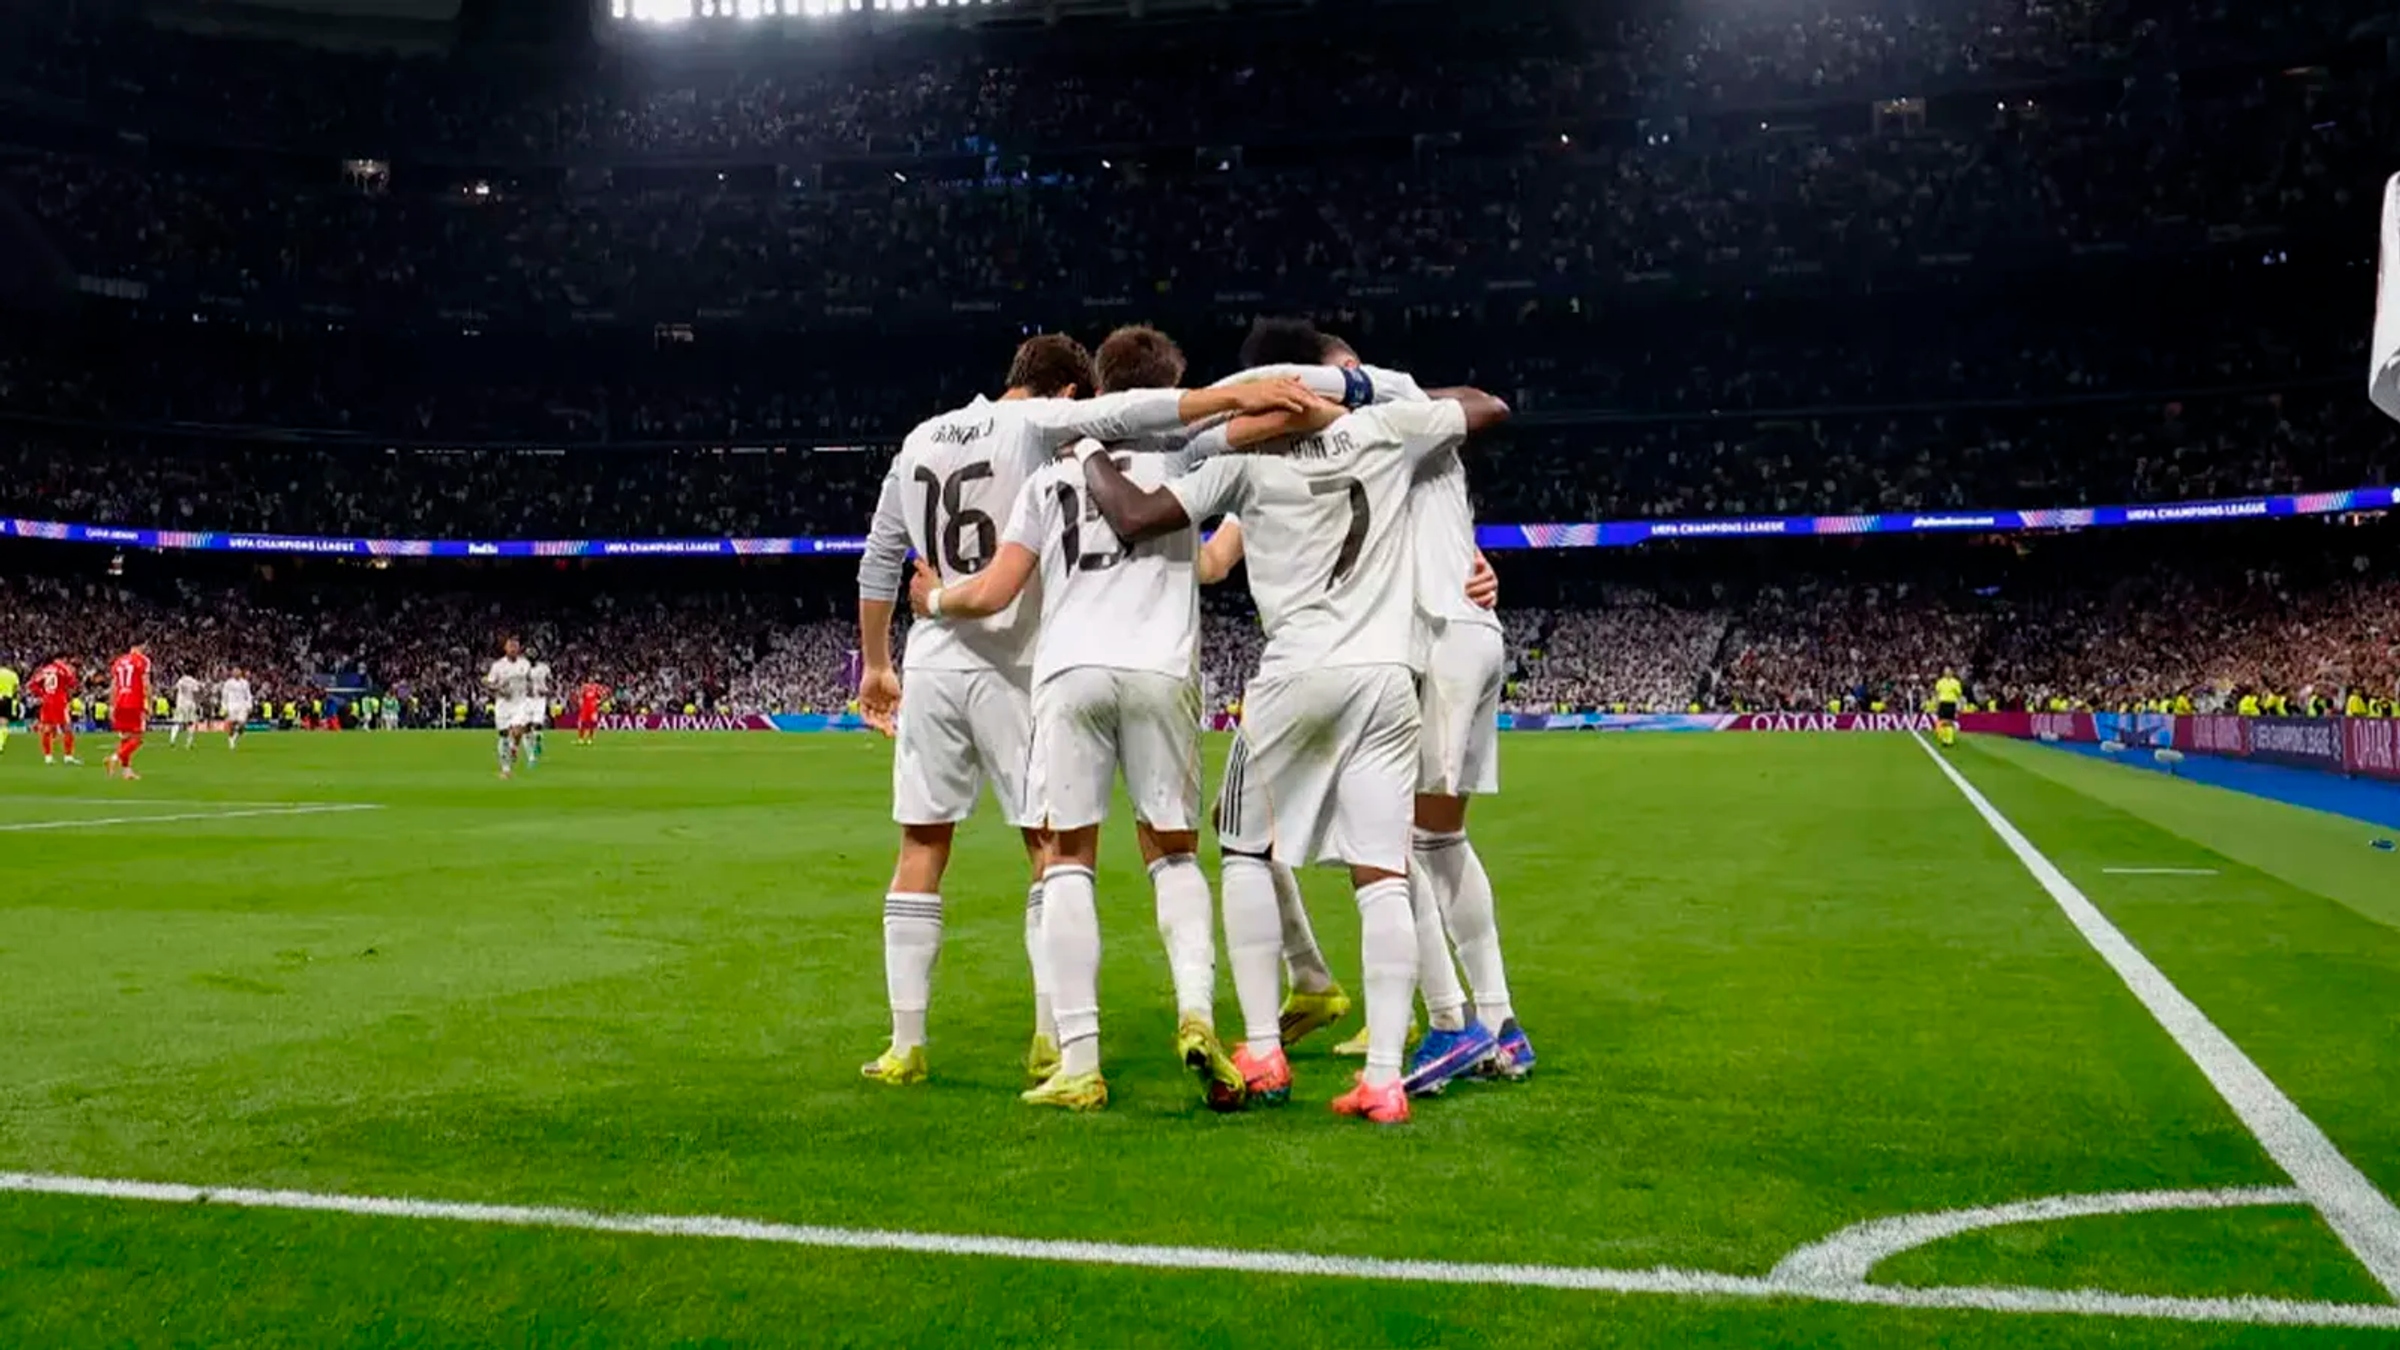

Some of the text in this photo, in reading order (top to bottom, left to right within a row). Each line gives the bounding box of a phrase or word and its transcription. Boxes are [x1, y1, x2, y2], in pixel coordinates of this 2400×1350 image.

[1332, 430, 1360, 456] JR.
[914, 460, 996, 578] 16
[1308, 477, 1370, 592] 7
[117, 664, 134, 687] 17
[597, 714, 748, 731] ATAR AIRWAYS
[1752, 713, 1838, 731] QATAR
